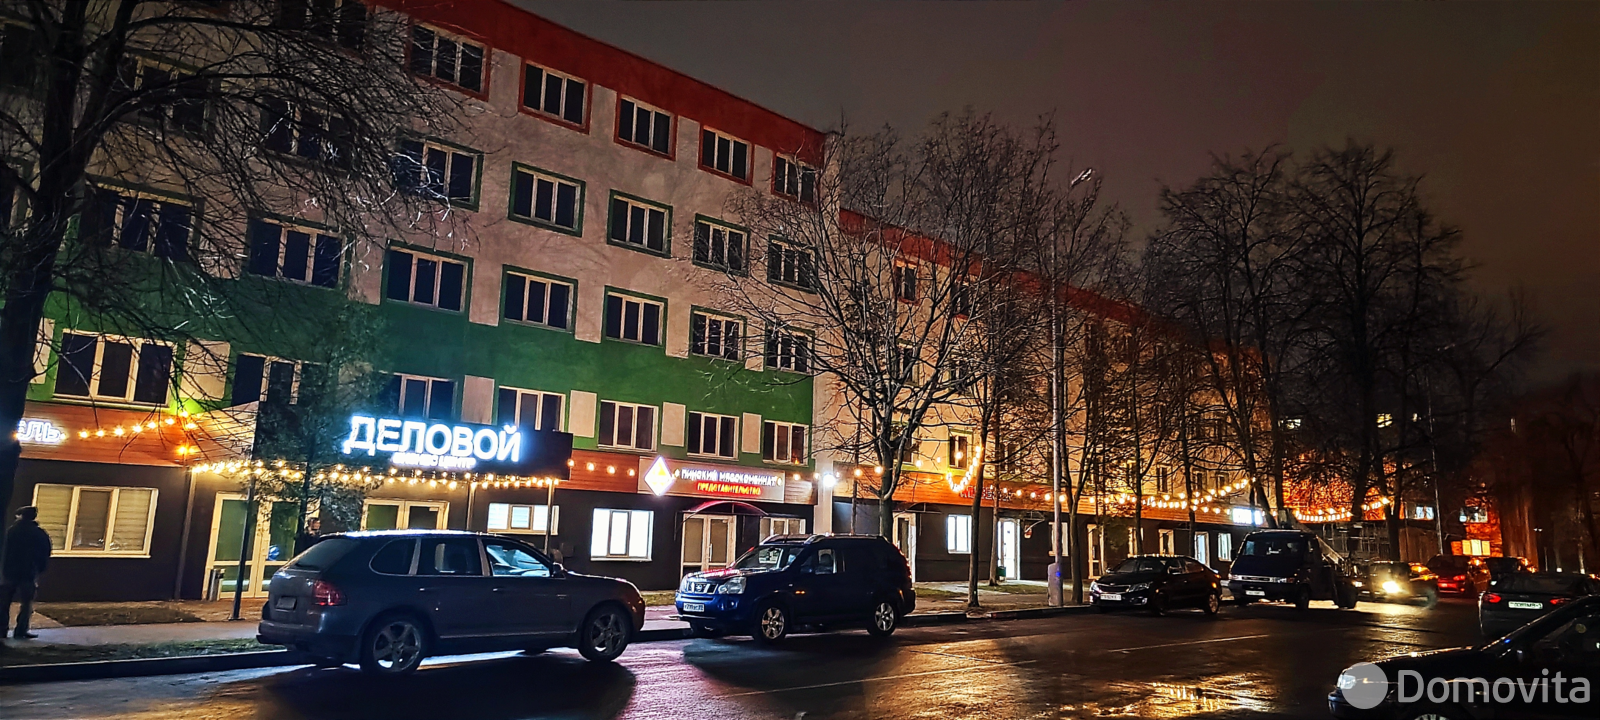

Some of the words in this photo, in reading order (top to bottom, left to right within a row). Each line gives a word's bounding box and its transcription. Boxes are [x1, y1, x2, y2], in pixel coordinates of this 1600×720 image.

[343, 416, 521, 462] ДЕЛОВОЙ
[681, 468, 719, 481] ПИНСКИЙ
[719, 472, 777, 486] МЯСОКОМБИНАТ
[697, 482, 761, 495] ПРЕДСТАВИТЕЛЬСТВО
